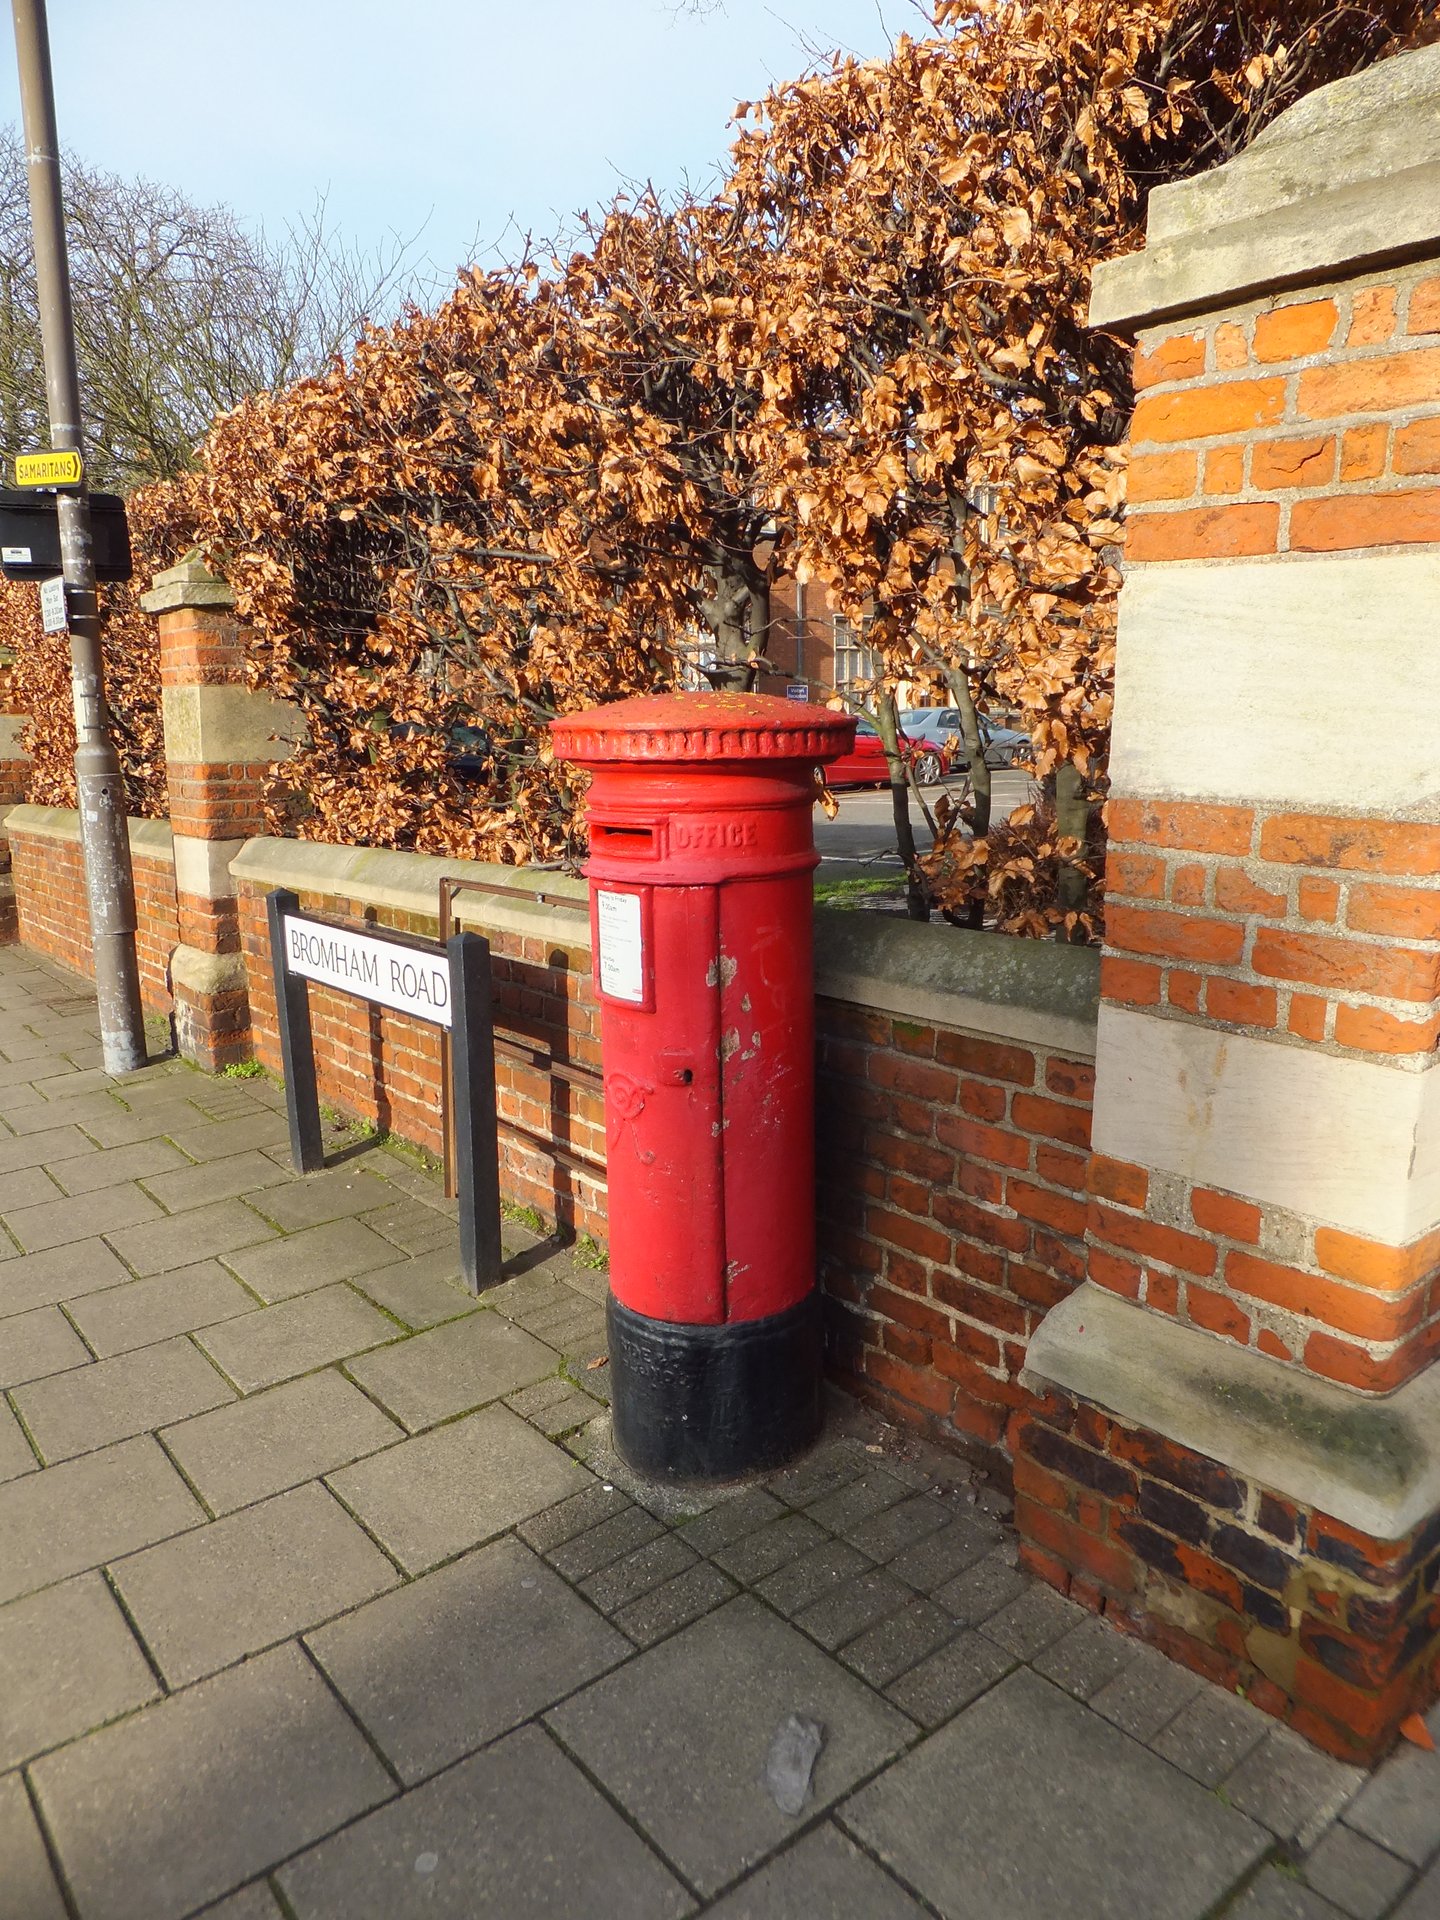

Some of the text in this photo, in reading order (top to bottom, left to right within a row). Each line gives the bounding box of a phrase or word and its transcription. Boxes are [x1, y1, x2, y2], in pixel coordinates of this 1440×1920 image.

[19, 460, 72, 479] SAMARITANS
[675, 823, 758, 849] OFFICE
[290, 929, 448, 1008] BROMHAM ROAD
